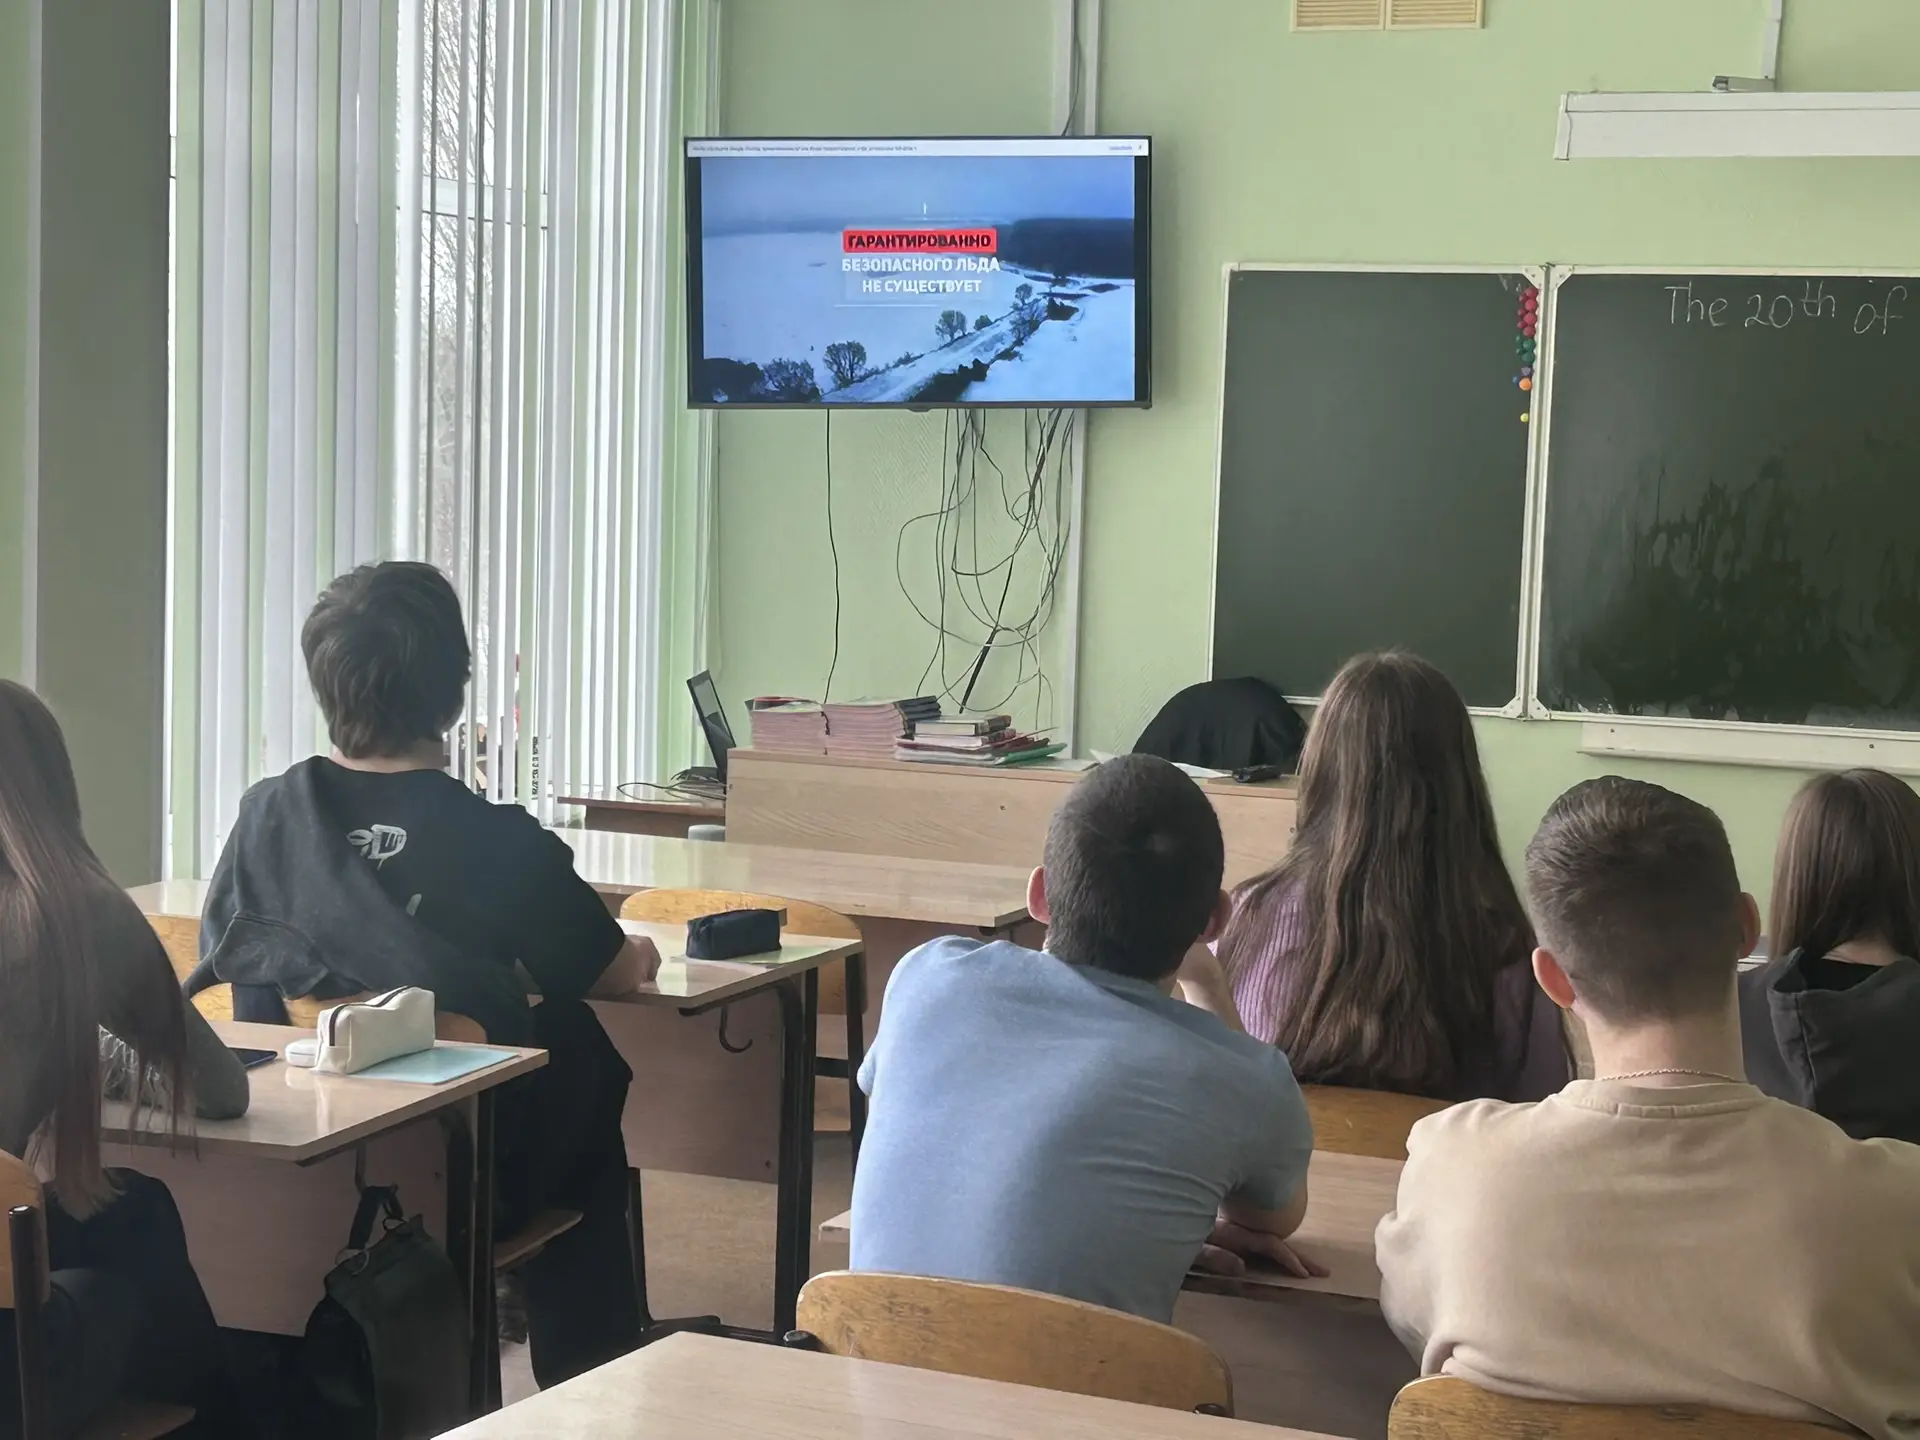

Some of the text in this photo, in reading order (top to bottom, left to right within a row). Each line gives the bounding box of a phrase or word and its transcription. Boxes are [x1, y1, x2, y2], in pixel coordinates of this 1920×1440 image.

[848, 234, 991, 248] ГАРАНТИРОВАННО
[842, 257, 1000, 273] БЕЗОПАСНОГО ЛЬДА
[862, 280, 982, 294] НЕ СУЩЕСТВУЕТ
[1664, 280, 1908, 335] The 20th of
